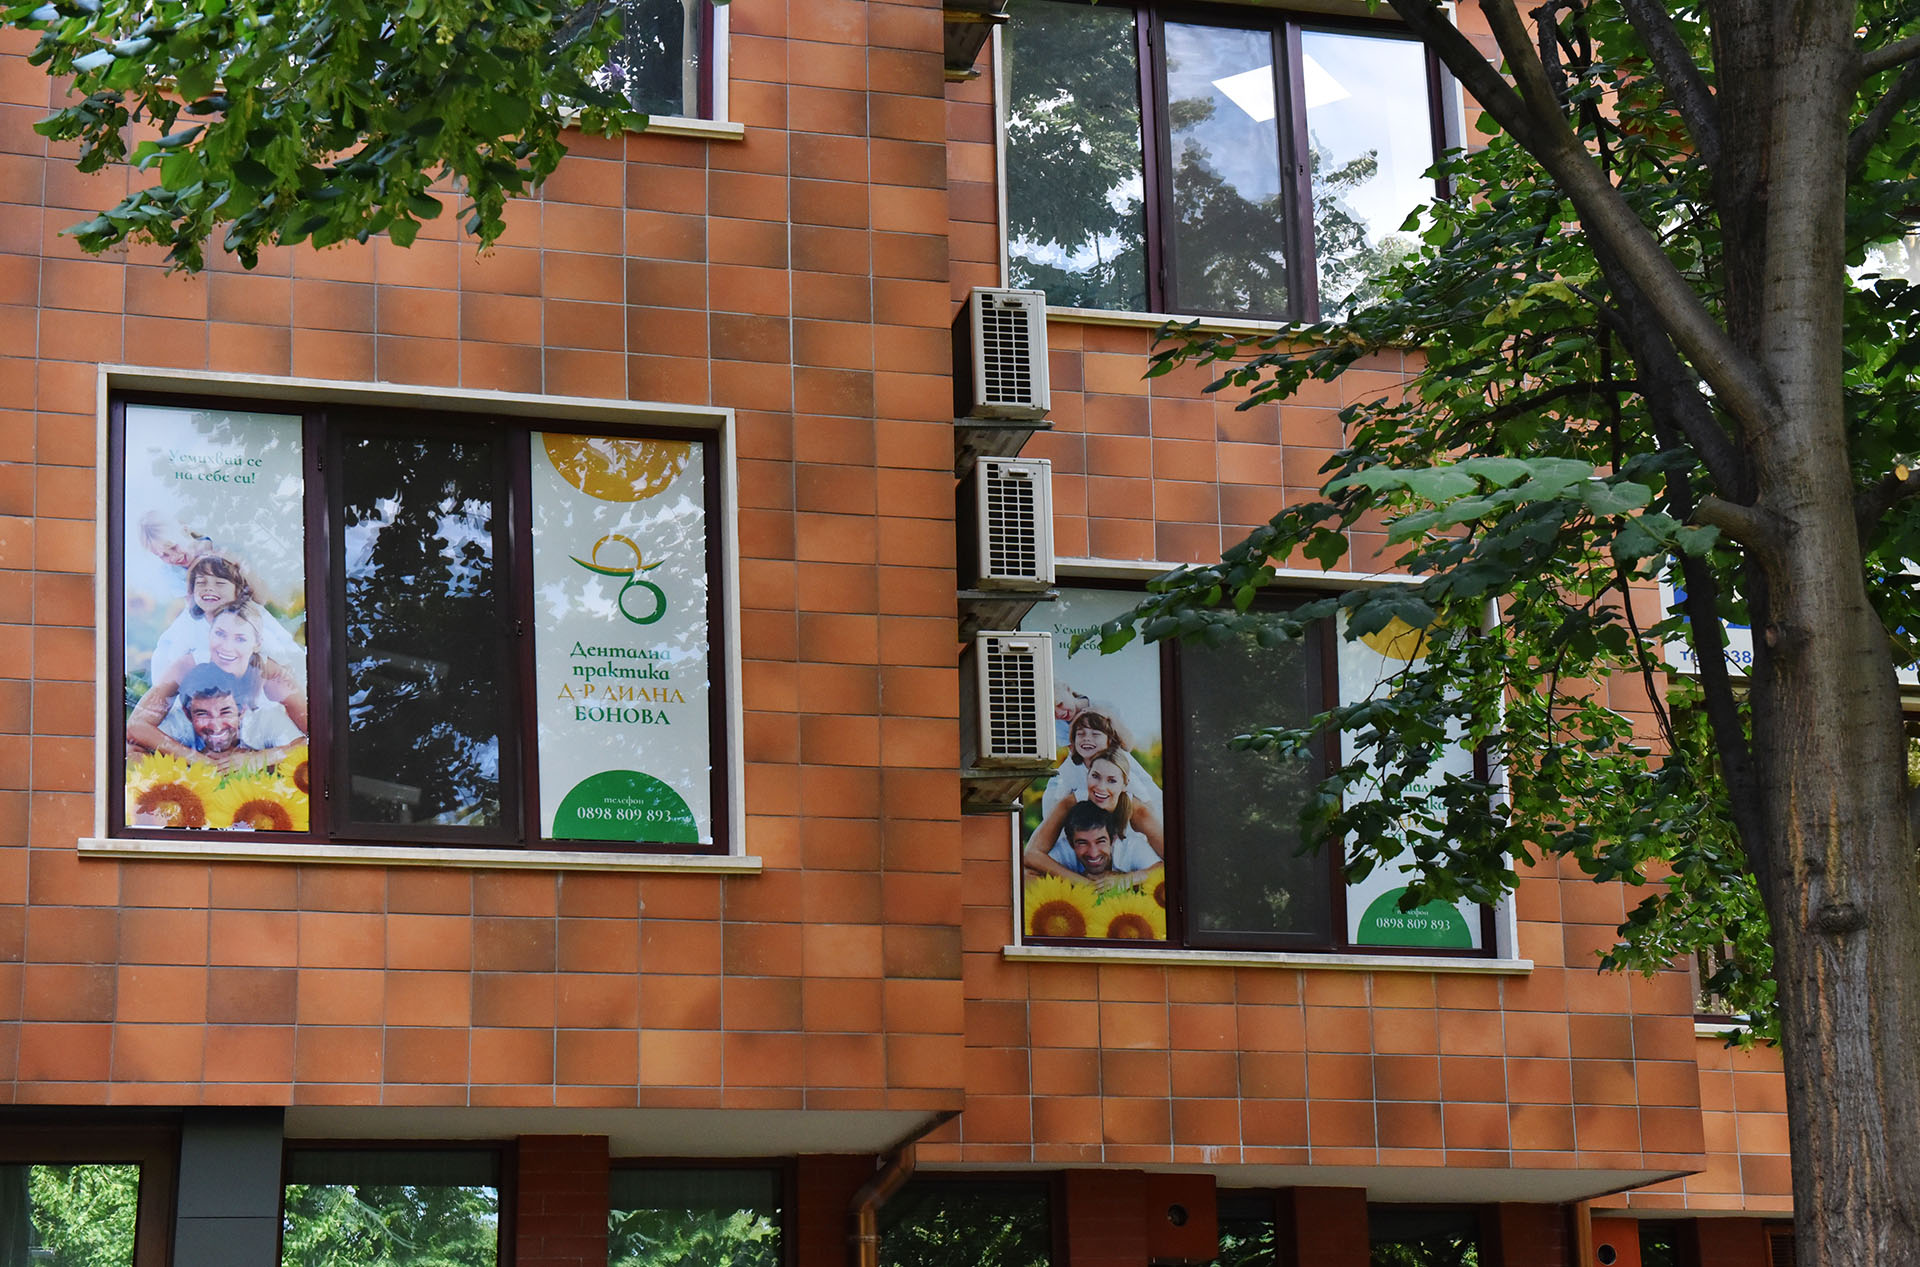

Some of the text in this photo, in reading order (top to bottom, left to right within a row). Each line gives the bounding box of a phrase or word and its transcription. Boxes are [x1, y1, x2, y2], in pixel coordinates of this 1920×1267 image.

[247, 457, 263, 467] се
[175, 470, 256, 484] на себе си!
[570, 641, 671, 660] Дентална
[573, 661, 670, 682] практика
[557, 683, 686, 704] Д-Р ДИАНА
[575, 705, 671, 725] БОНОВА
[604, 796, 644, 806] телефон
[577, 806, 671, 822] 0898 809 893
[1376, 917, 1451, 931] 0898 809 893
